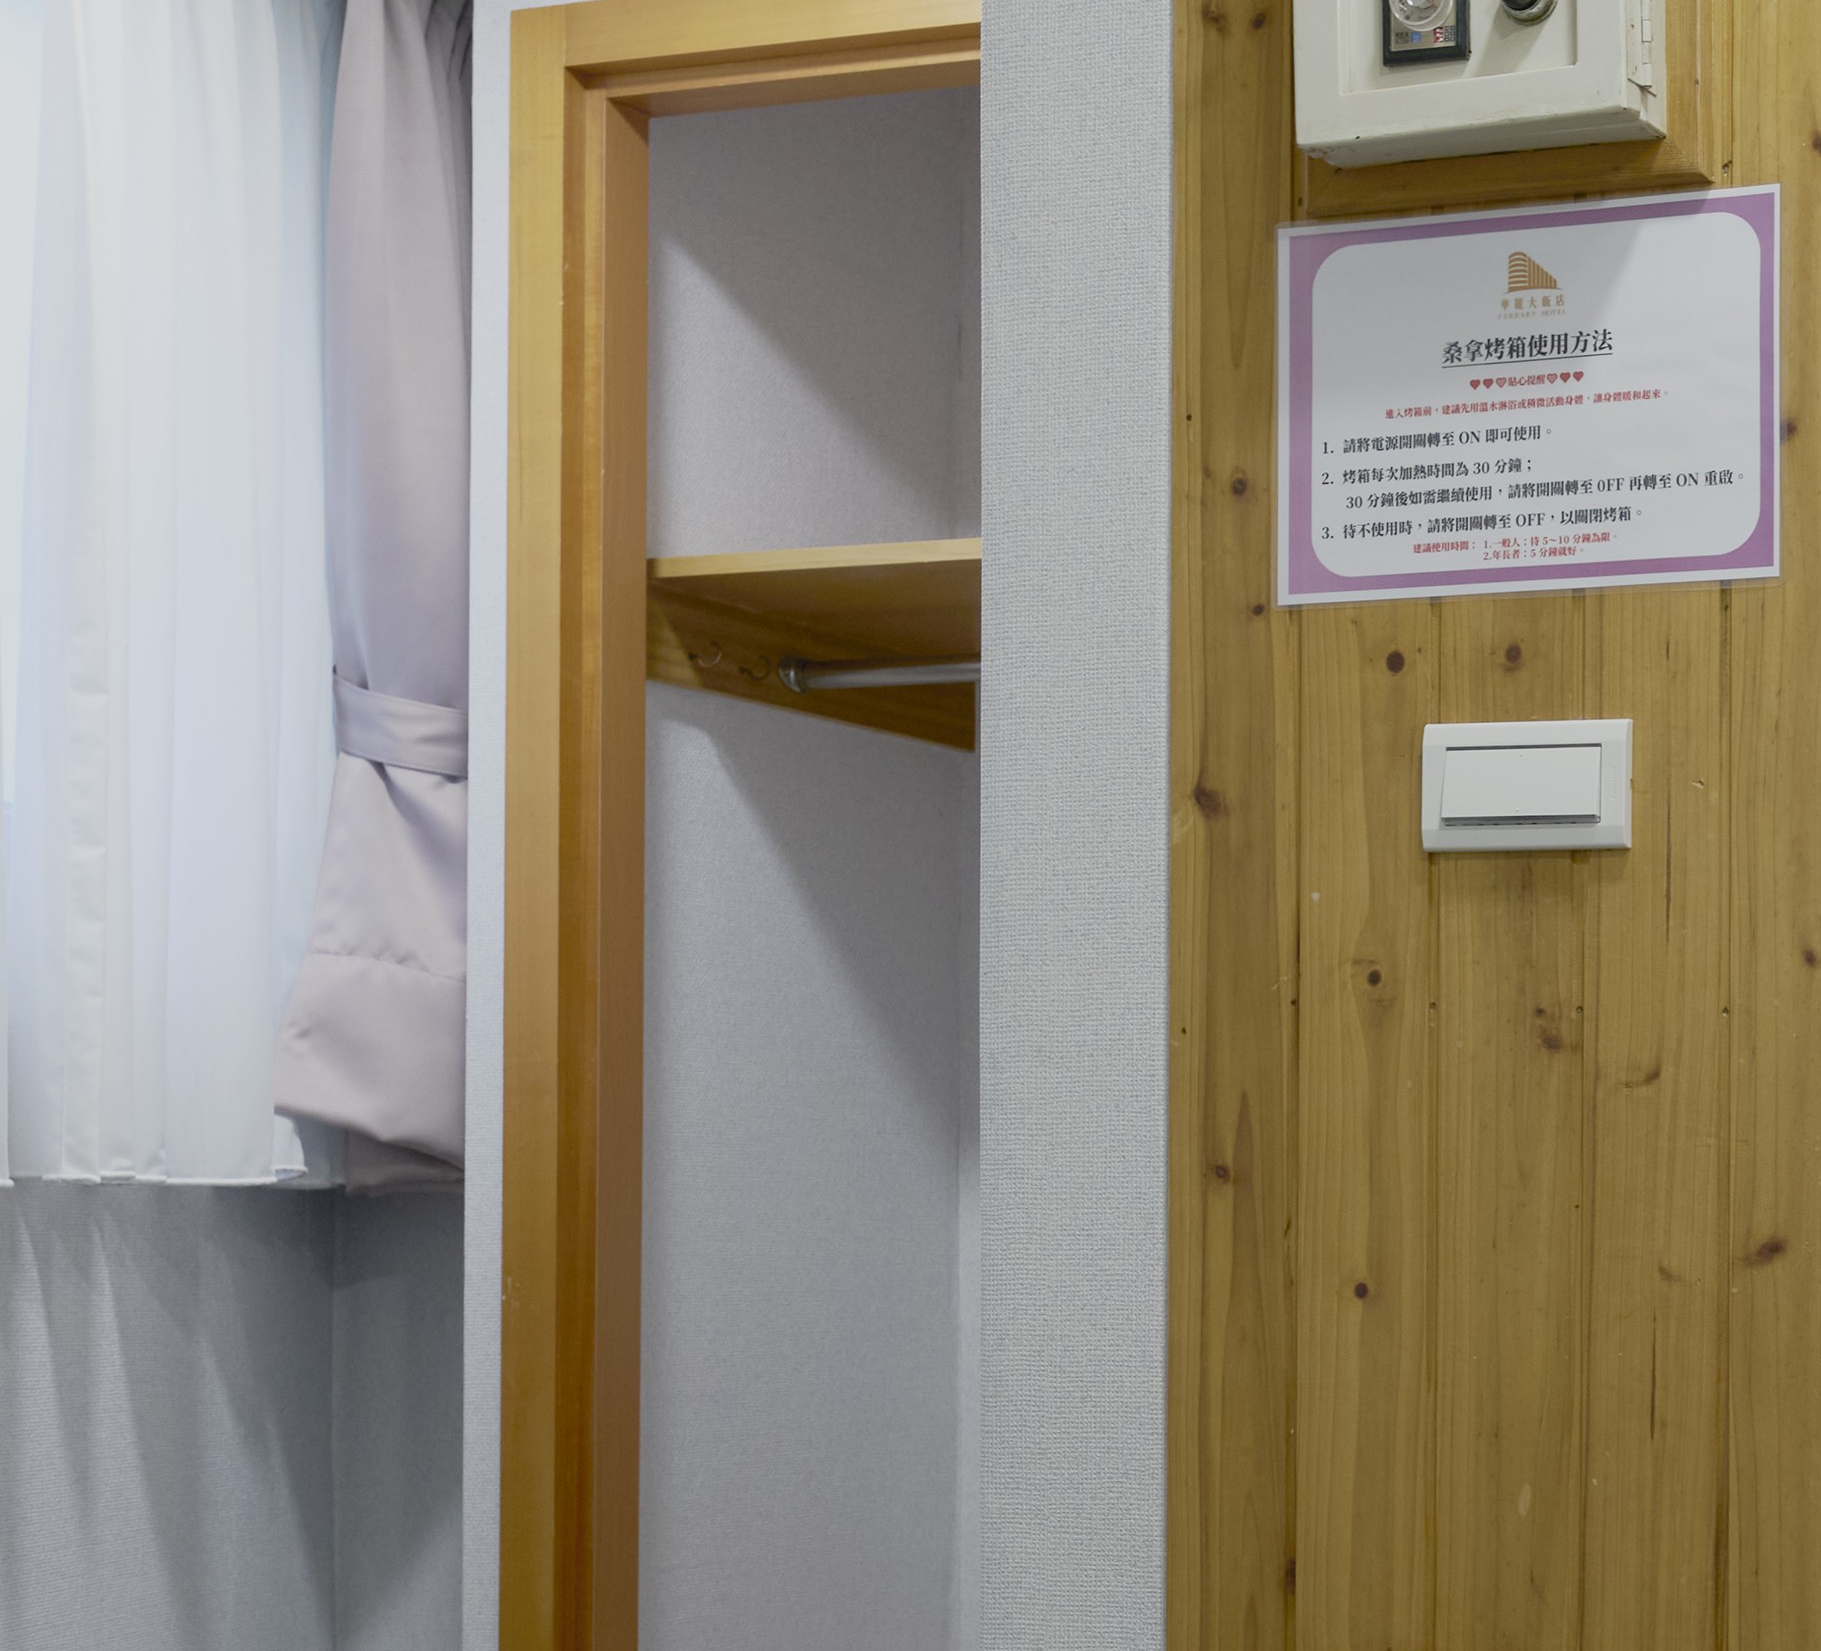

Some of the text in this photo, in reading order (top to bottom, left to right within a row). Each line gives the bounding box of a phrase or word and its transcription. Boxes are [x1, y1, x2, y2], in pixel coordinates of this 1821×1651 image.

[1442, 329, 1613, 364] 桑拿烤箱使用方法
[1508, 374, 1546, 387] 貼心提醒
[1473, 461, 1490, 475] 30
[1346, 496, 1363, 509] 30
